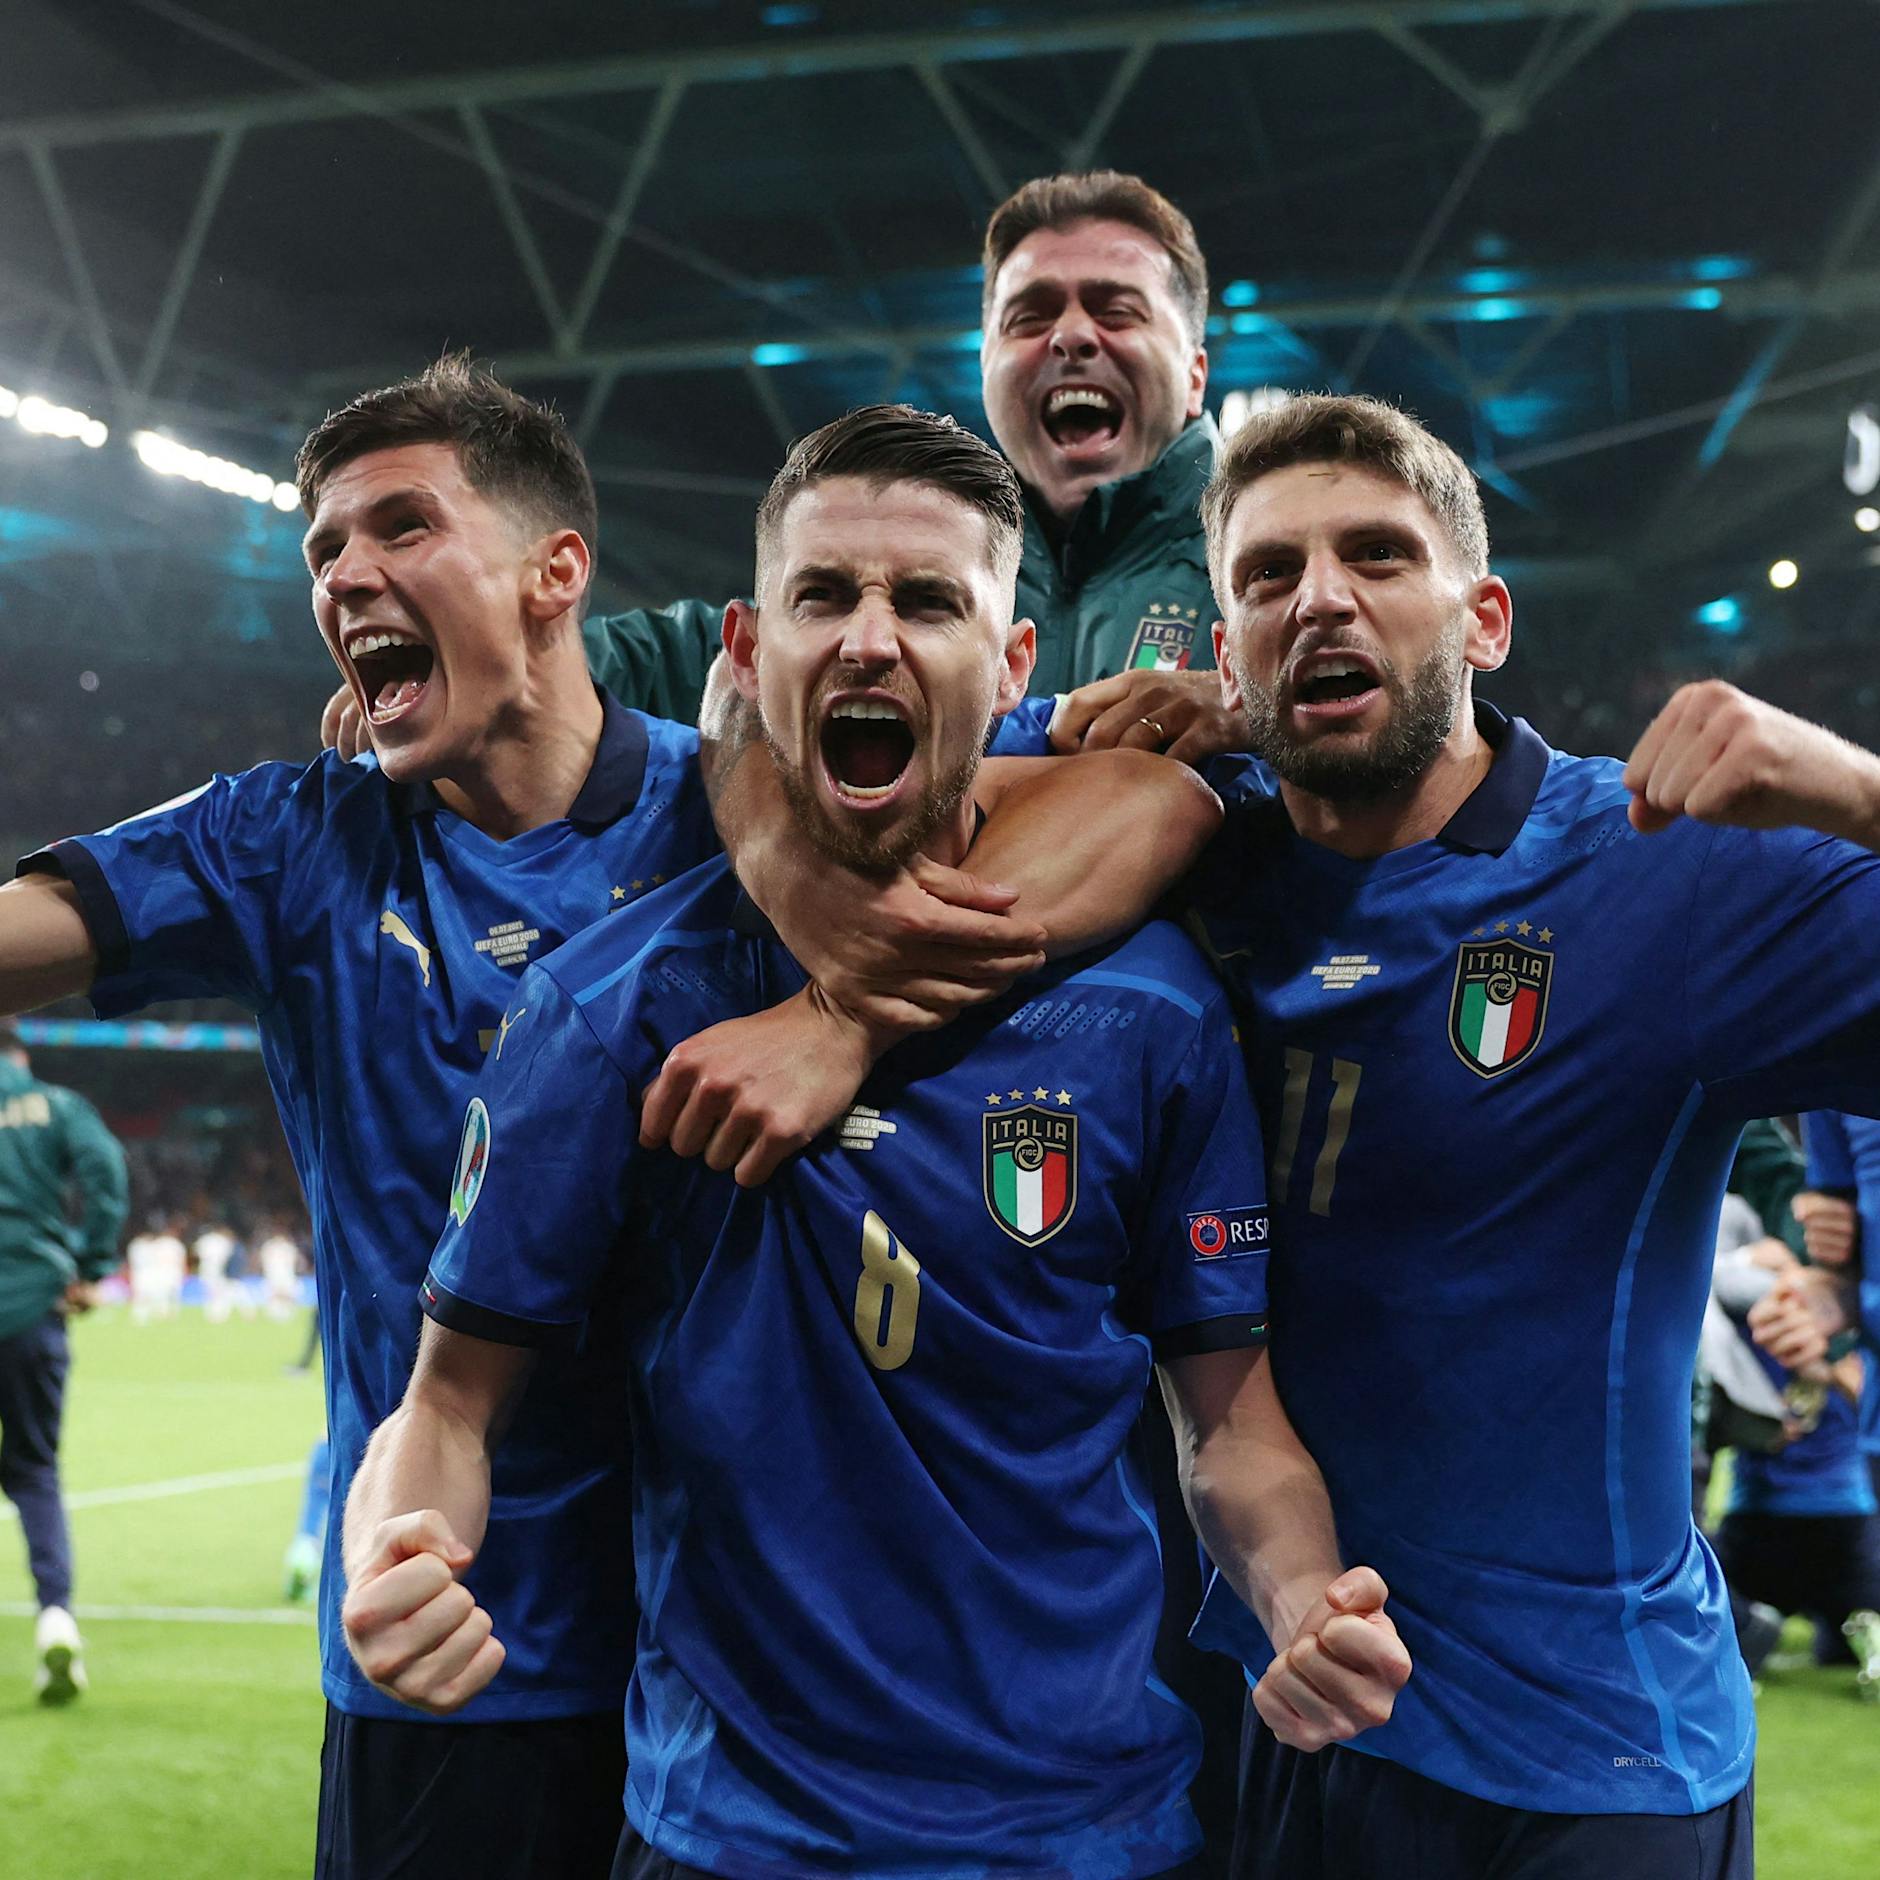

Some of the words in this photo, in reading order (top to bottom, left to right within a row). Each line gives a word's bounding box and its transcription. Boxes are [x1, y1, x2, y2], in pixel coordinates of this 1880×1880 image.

[1144, 625, 1193, 642] ITALI
[475, 939, 497, 951] UEFA
[498, 935, 518, 946] EURO
[520, 929, 539, 940] 2020
[1312, 966, 1333, 975] UEFA
[1334, 966, 1356, 975] EURO
[1357, 966, 1380, 975] 2020
[1467, 953, 1543, 978] ITALIA
[871, 1120, 896, 1133] 2020
[992, 1119, 1067, 1141] ITALIA
[1272, 1047, 1362, 1217] 11
[1195, 1217, 1217, 1228] UEFA
[854, 1209, 920, 1371] 8
[1612, 1756, 1661, 1767] DRYCELL
